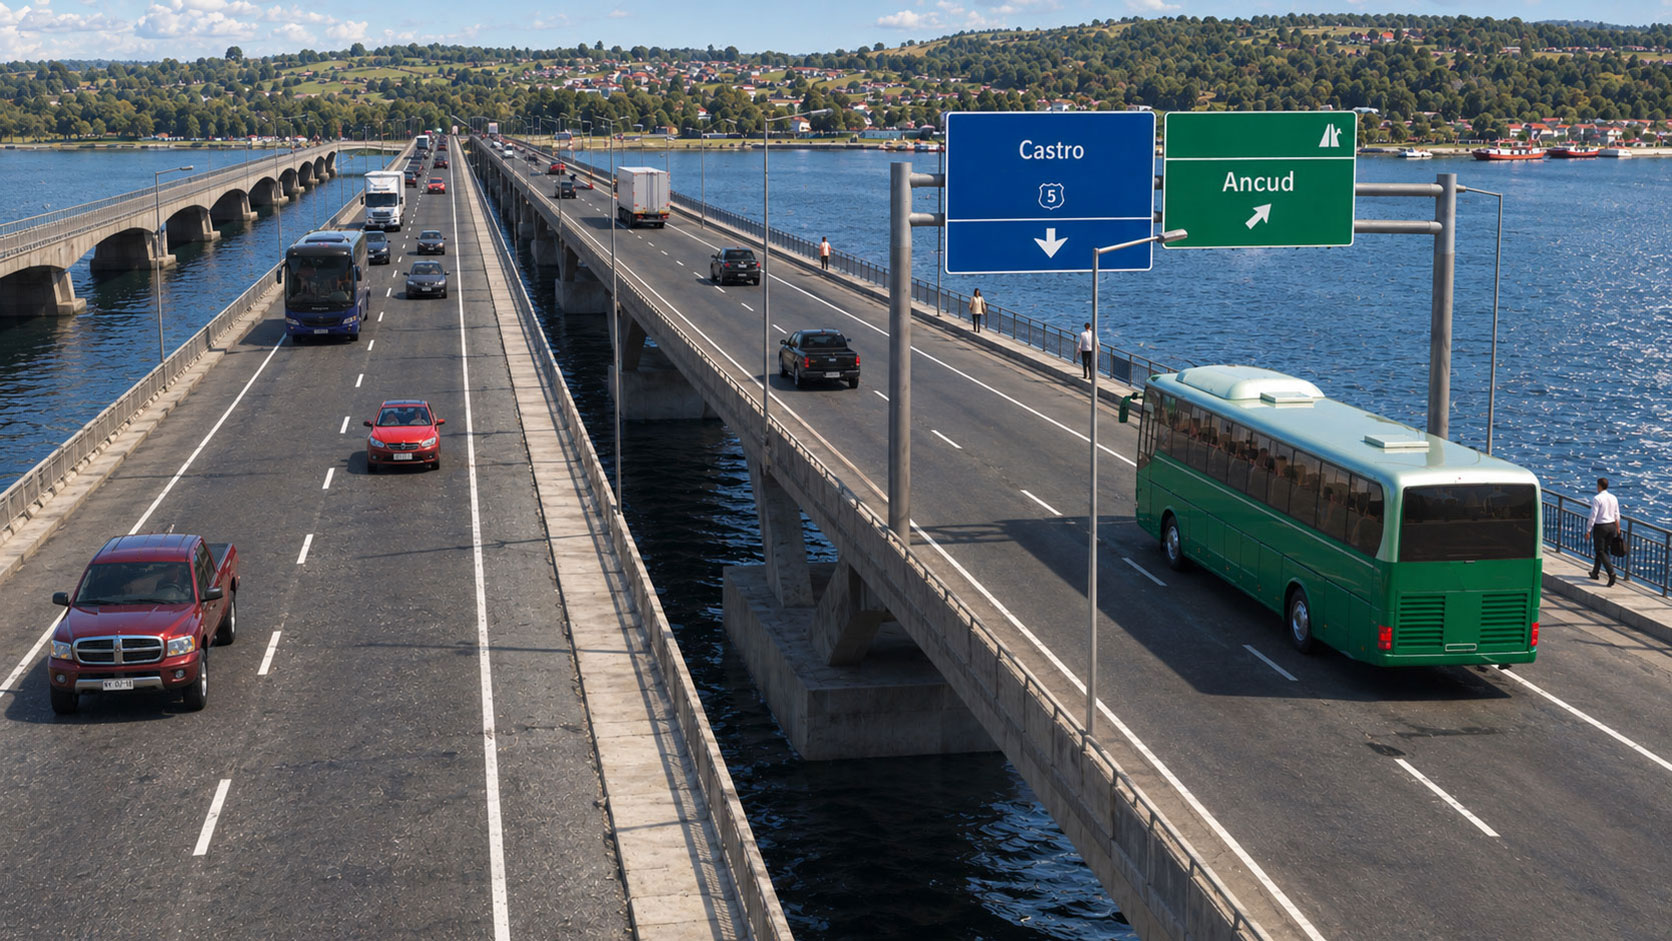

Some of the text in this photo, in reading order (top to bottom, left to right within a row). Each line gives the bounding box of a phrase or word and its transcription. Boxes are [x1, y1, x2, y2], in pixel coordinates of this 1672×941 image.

[1019, 140, 1084, 160] Castro
[1222, 170, 1294, 192] Ancud
[1047, 189, 1057, 203] 5
